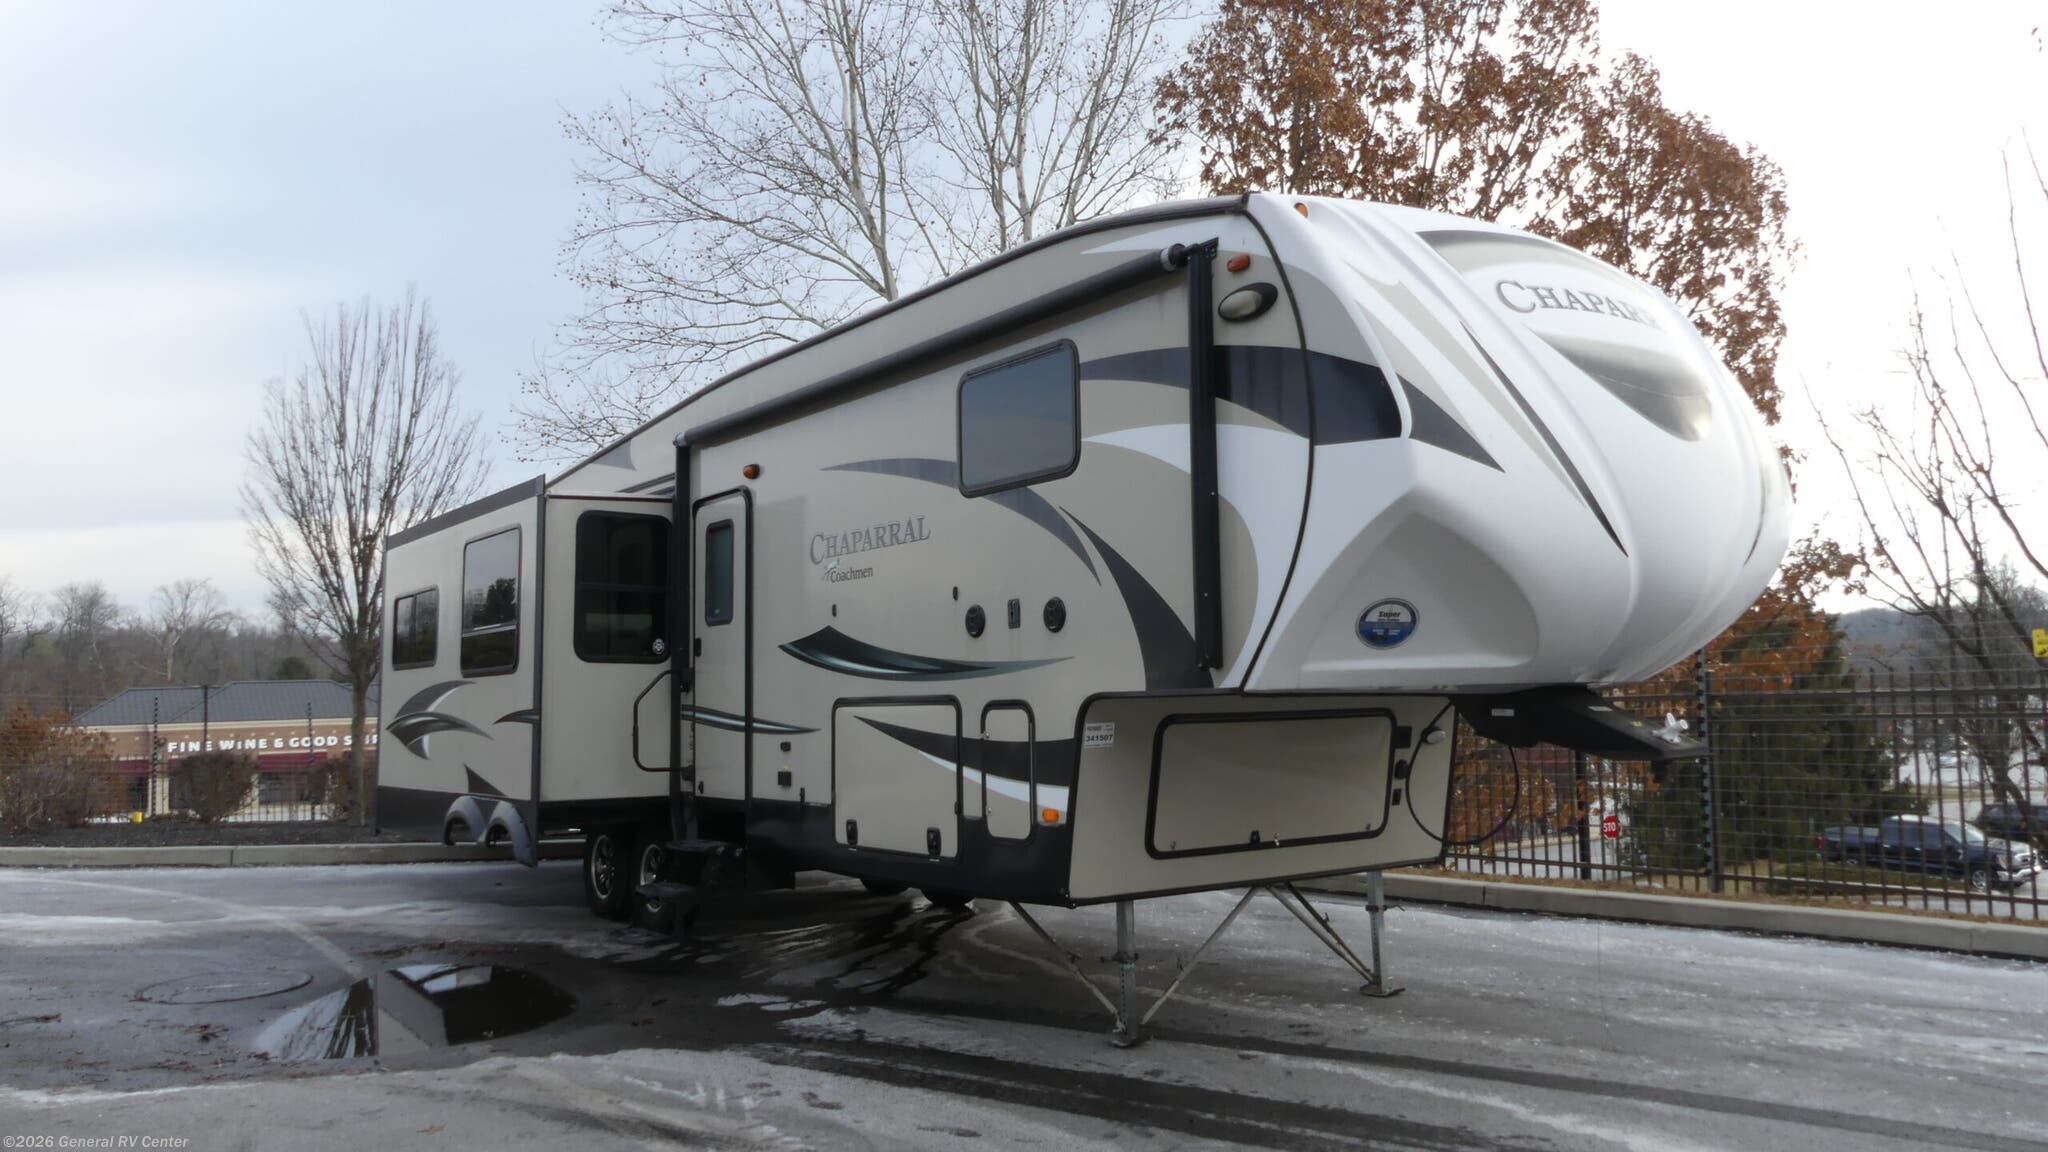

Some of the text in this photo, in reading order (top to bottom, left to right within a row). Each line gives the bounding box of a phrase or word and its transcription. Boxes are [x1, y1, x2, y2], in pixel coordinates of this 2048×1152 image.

[809, 516, 931, 565] CHAPARRAL
[830, 566, 874, 583] Coachmen
[167, 741, 213, 752] FINE
[219, 739, 268, 750] WINE
[289, 736, 338, 748] GOOD
